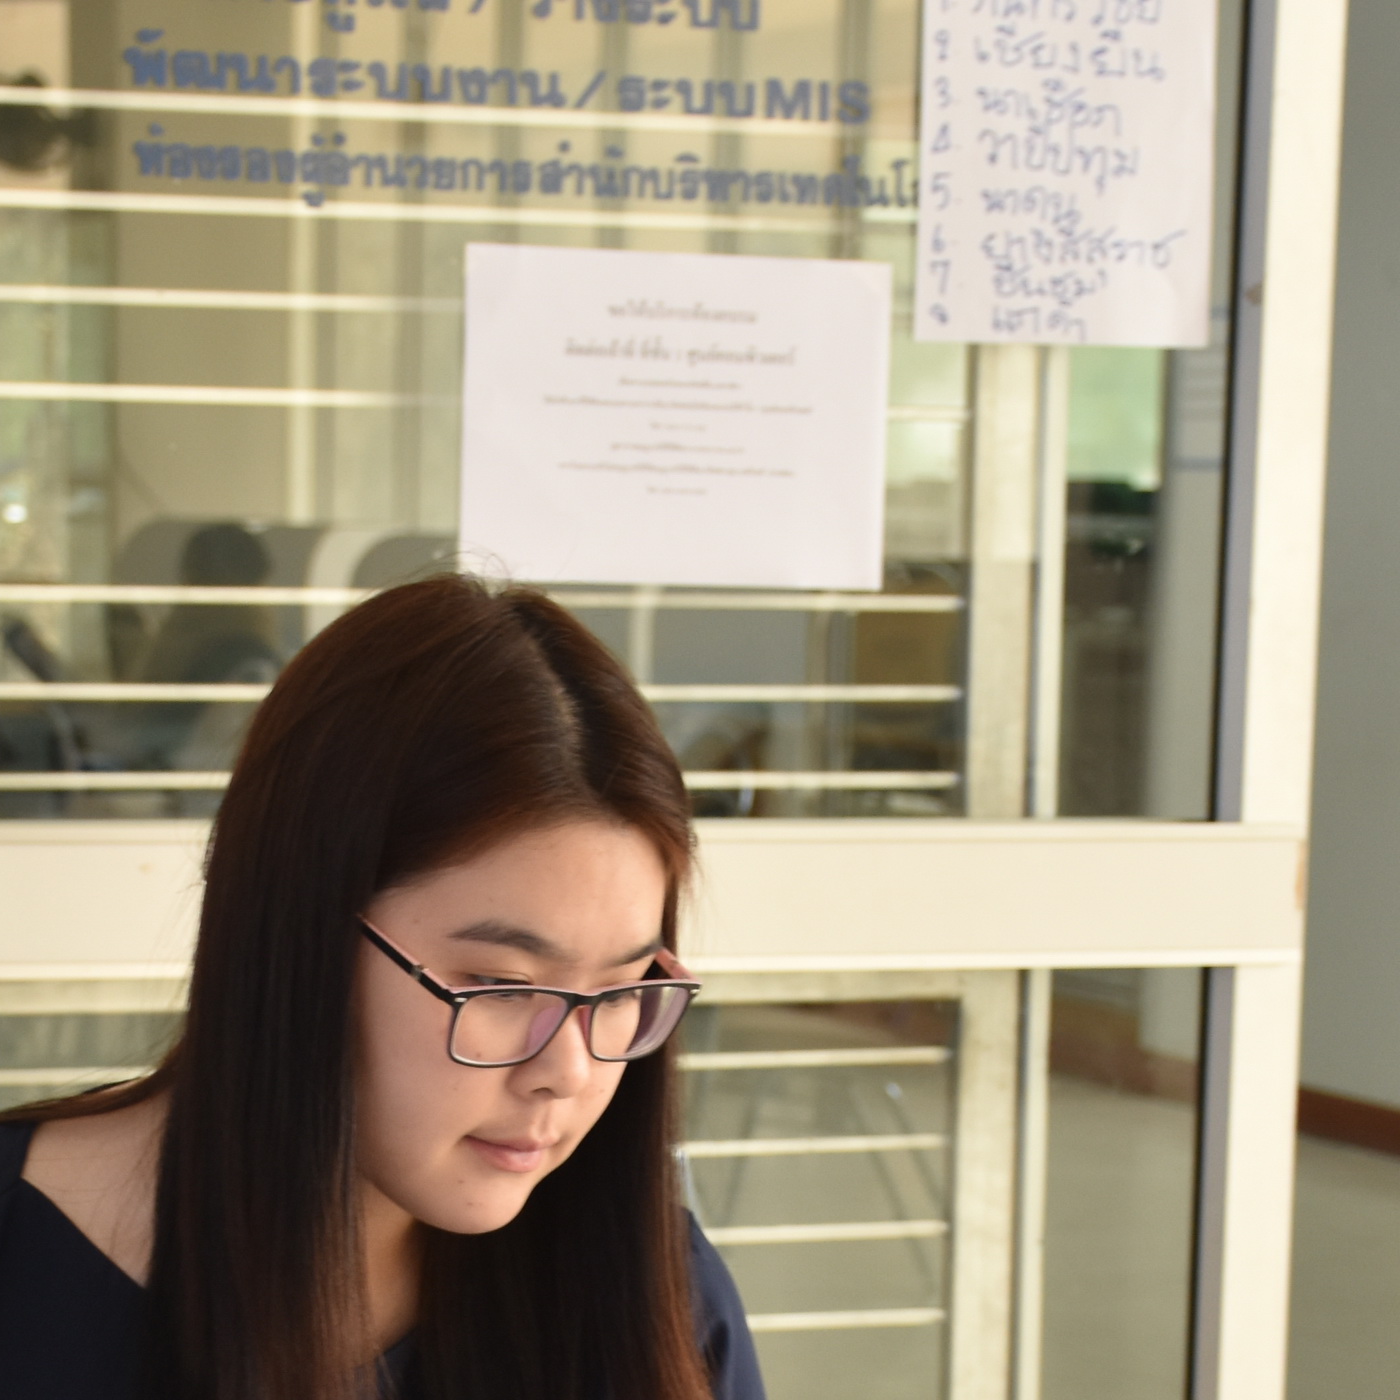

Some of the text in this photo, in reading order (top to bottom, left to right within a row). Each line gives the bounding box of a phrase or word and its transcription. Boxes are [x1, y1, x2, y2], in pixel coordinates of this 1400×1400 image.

[133, 123, 918, 208] ห้องรองผู้อำนวยการสำนักบริหารเทคโนโ
